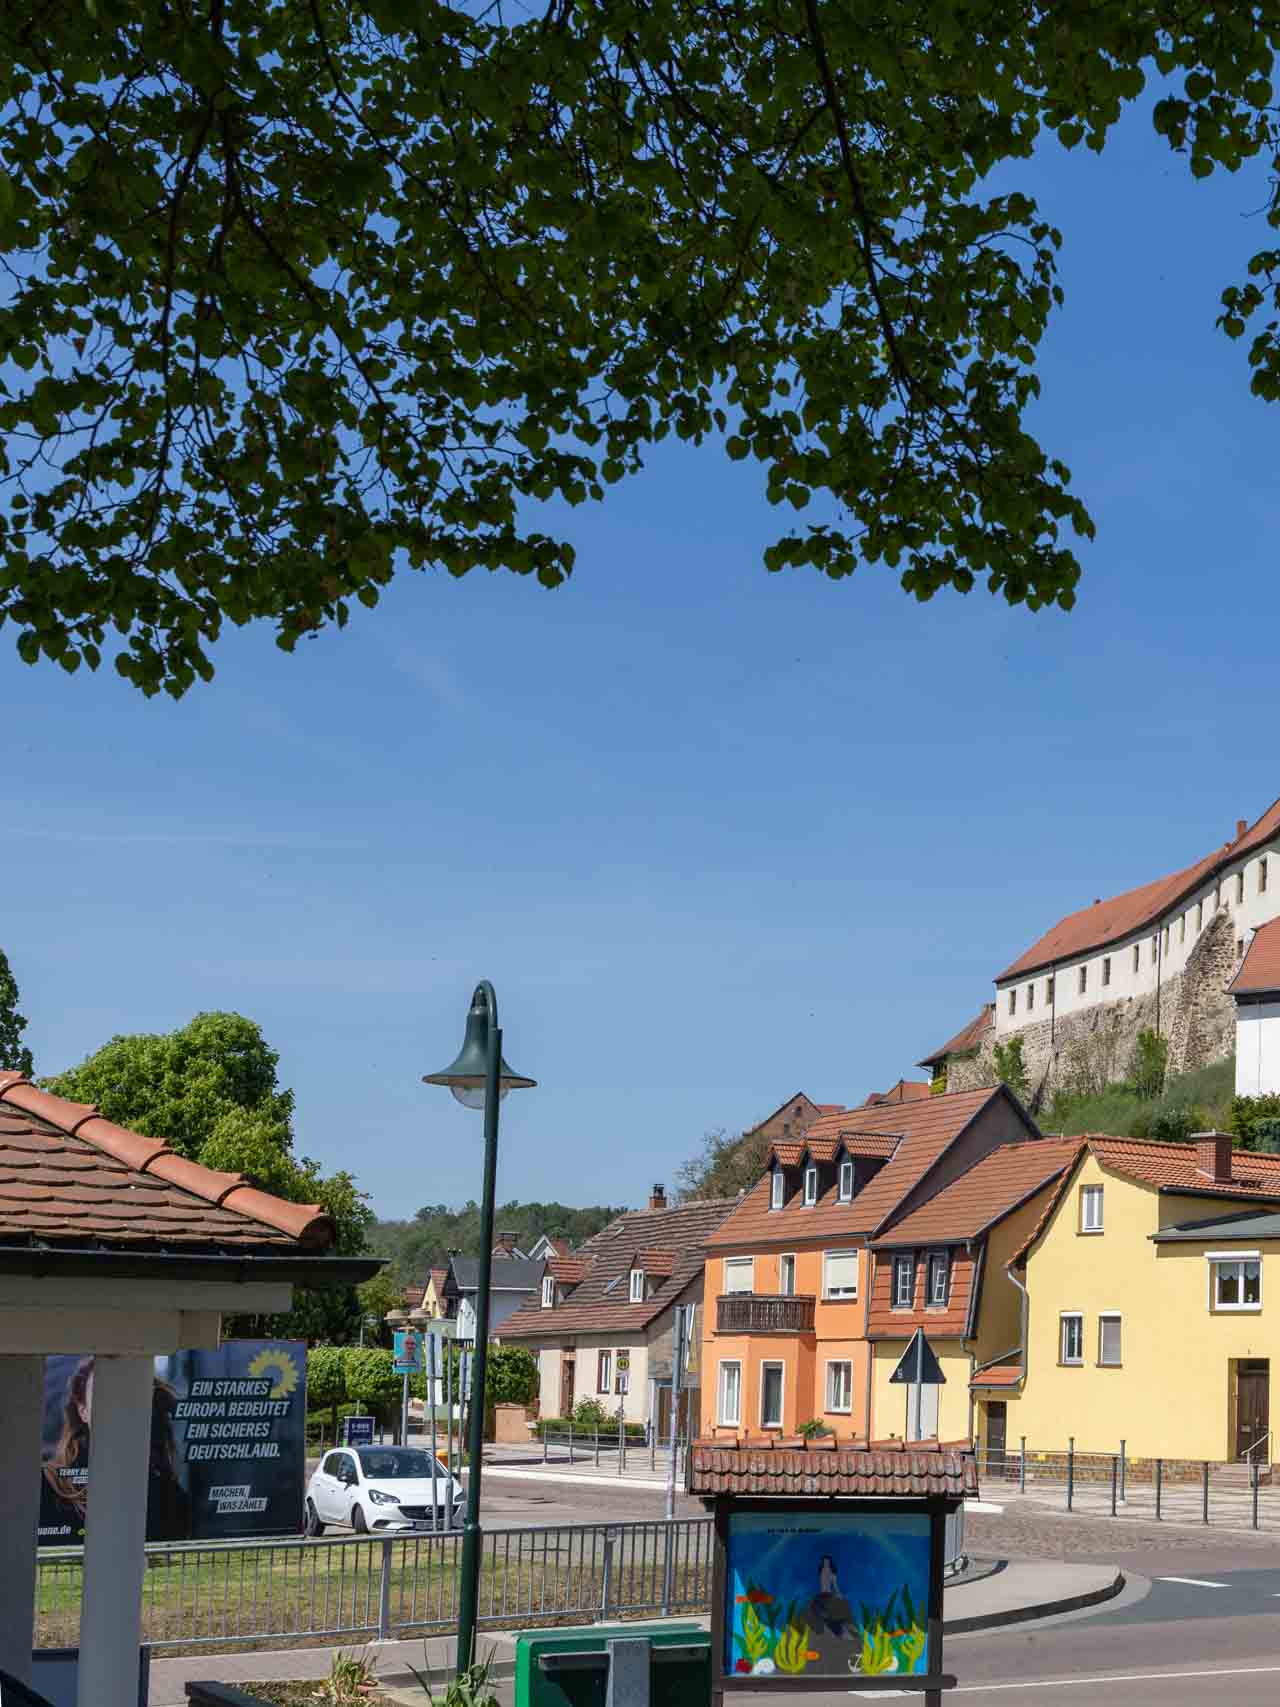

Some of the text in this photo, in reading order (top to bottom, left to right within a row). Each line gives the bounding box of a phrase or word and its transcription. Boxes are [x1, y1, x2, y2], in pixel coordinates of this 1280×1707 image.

[191, 1380, 270, 1396] EIN STARKES
[175, 1401, 290, 1417] EUROPA BEDEUTET
[187, 1422, 270, 1438] EIN SICHERES
[188, 1442, 280, 1460] DEUTSCHLAND.
